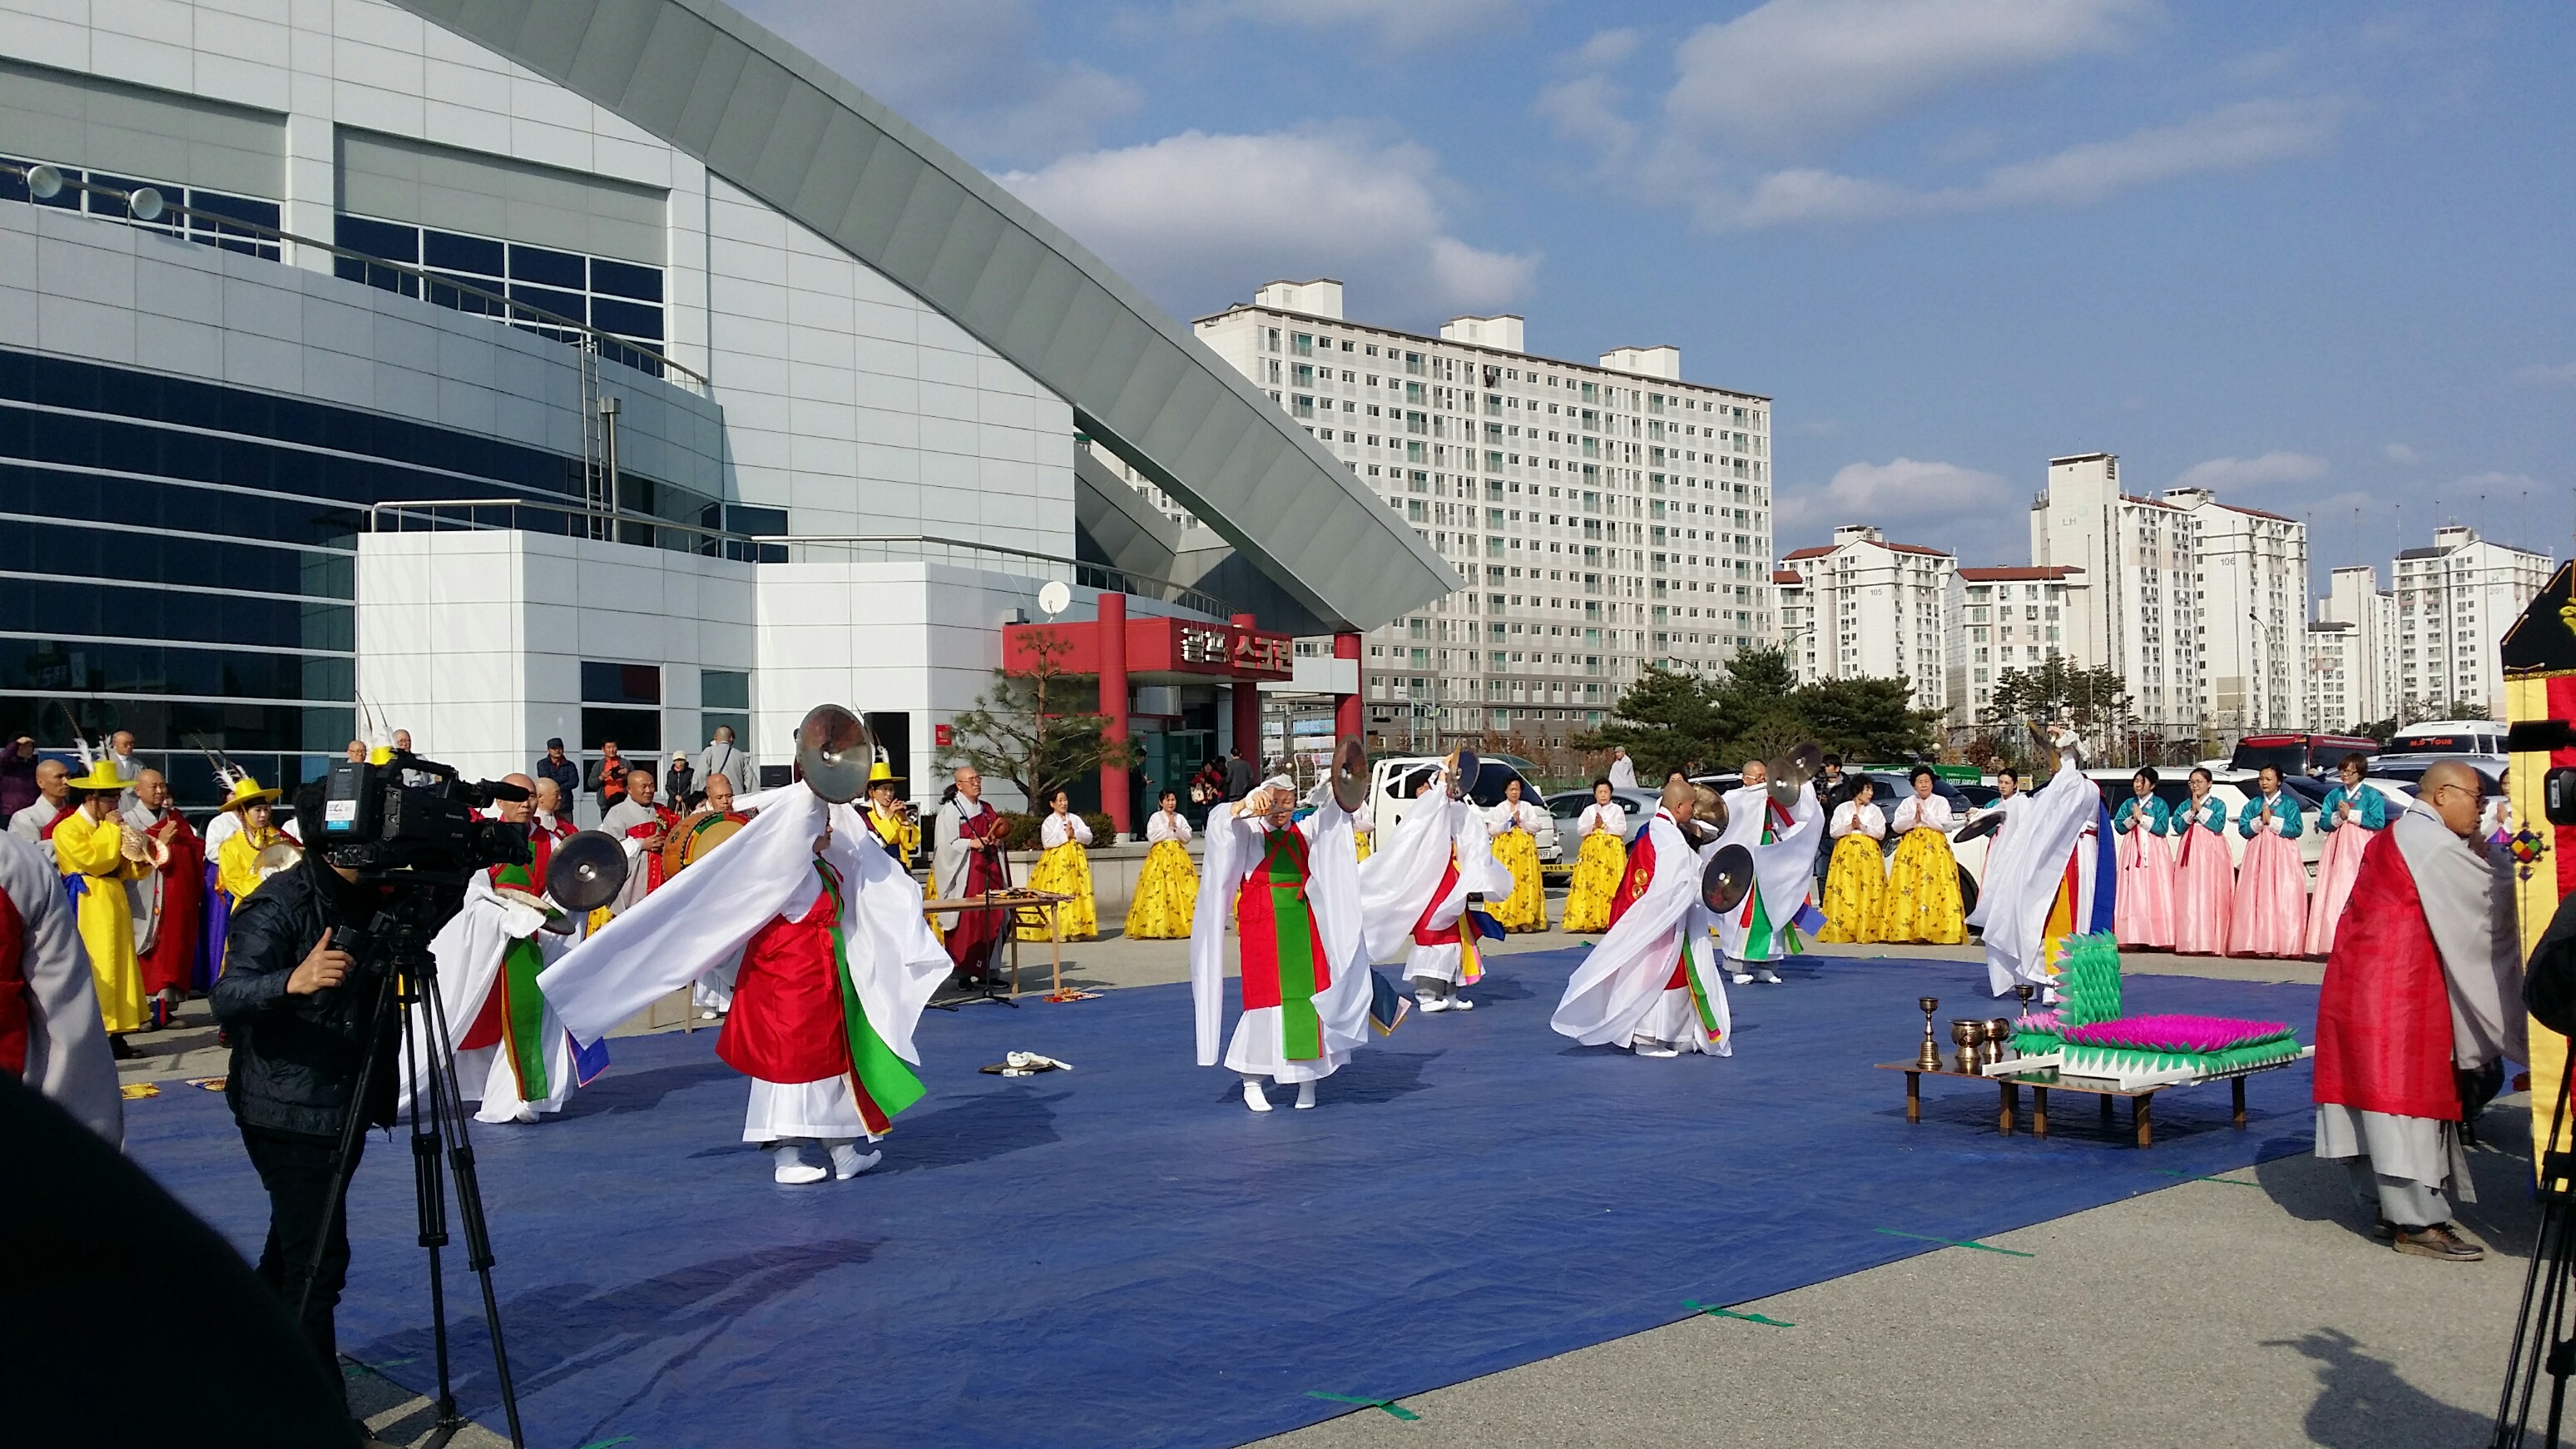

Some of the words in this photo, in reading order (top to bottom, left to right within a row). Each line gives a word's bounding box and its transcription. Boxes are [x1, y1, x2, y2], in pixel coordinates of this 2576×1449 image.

[2063, 517, 2077, 526] LH
[2220, 557, 2236, 566] 106
[1870, 588, 1883, 596] 105
[2489, 586, 2504, 595] 201
[1181, 628, 1226, 663] 골프
[1233, 634, 1293, 672] 스크린
